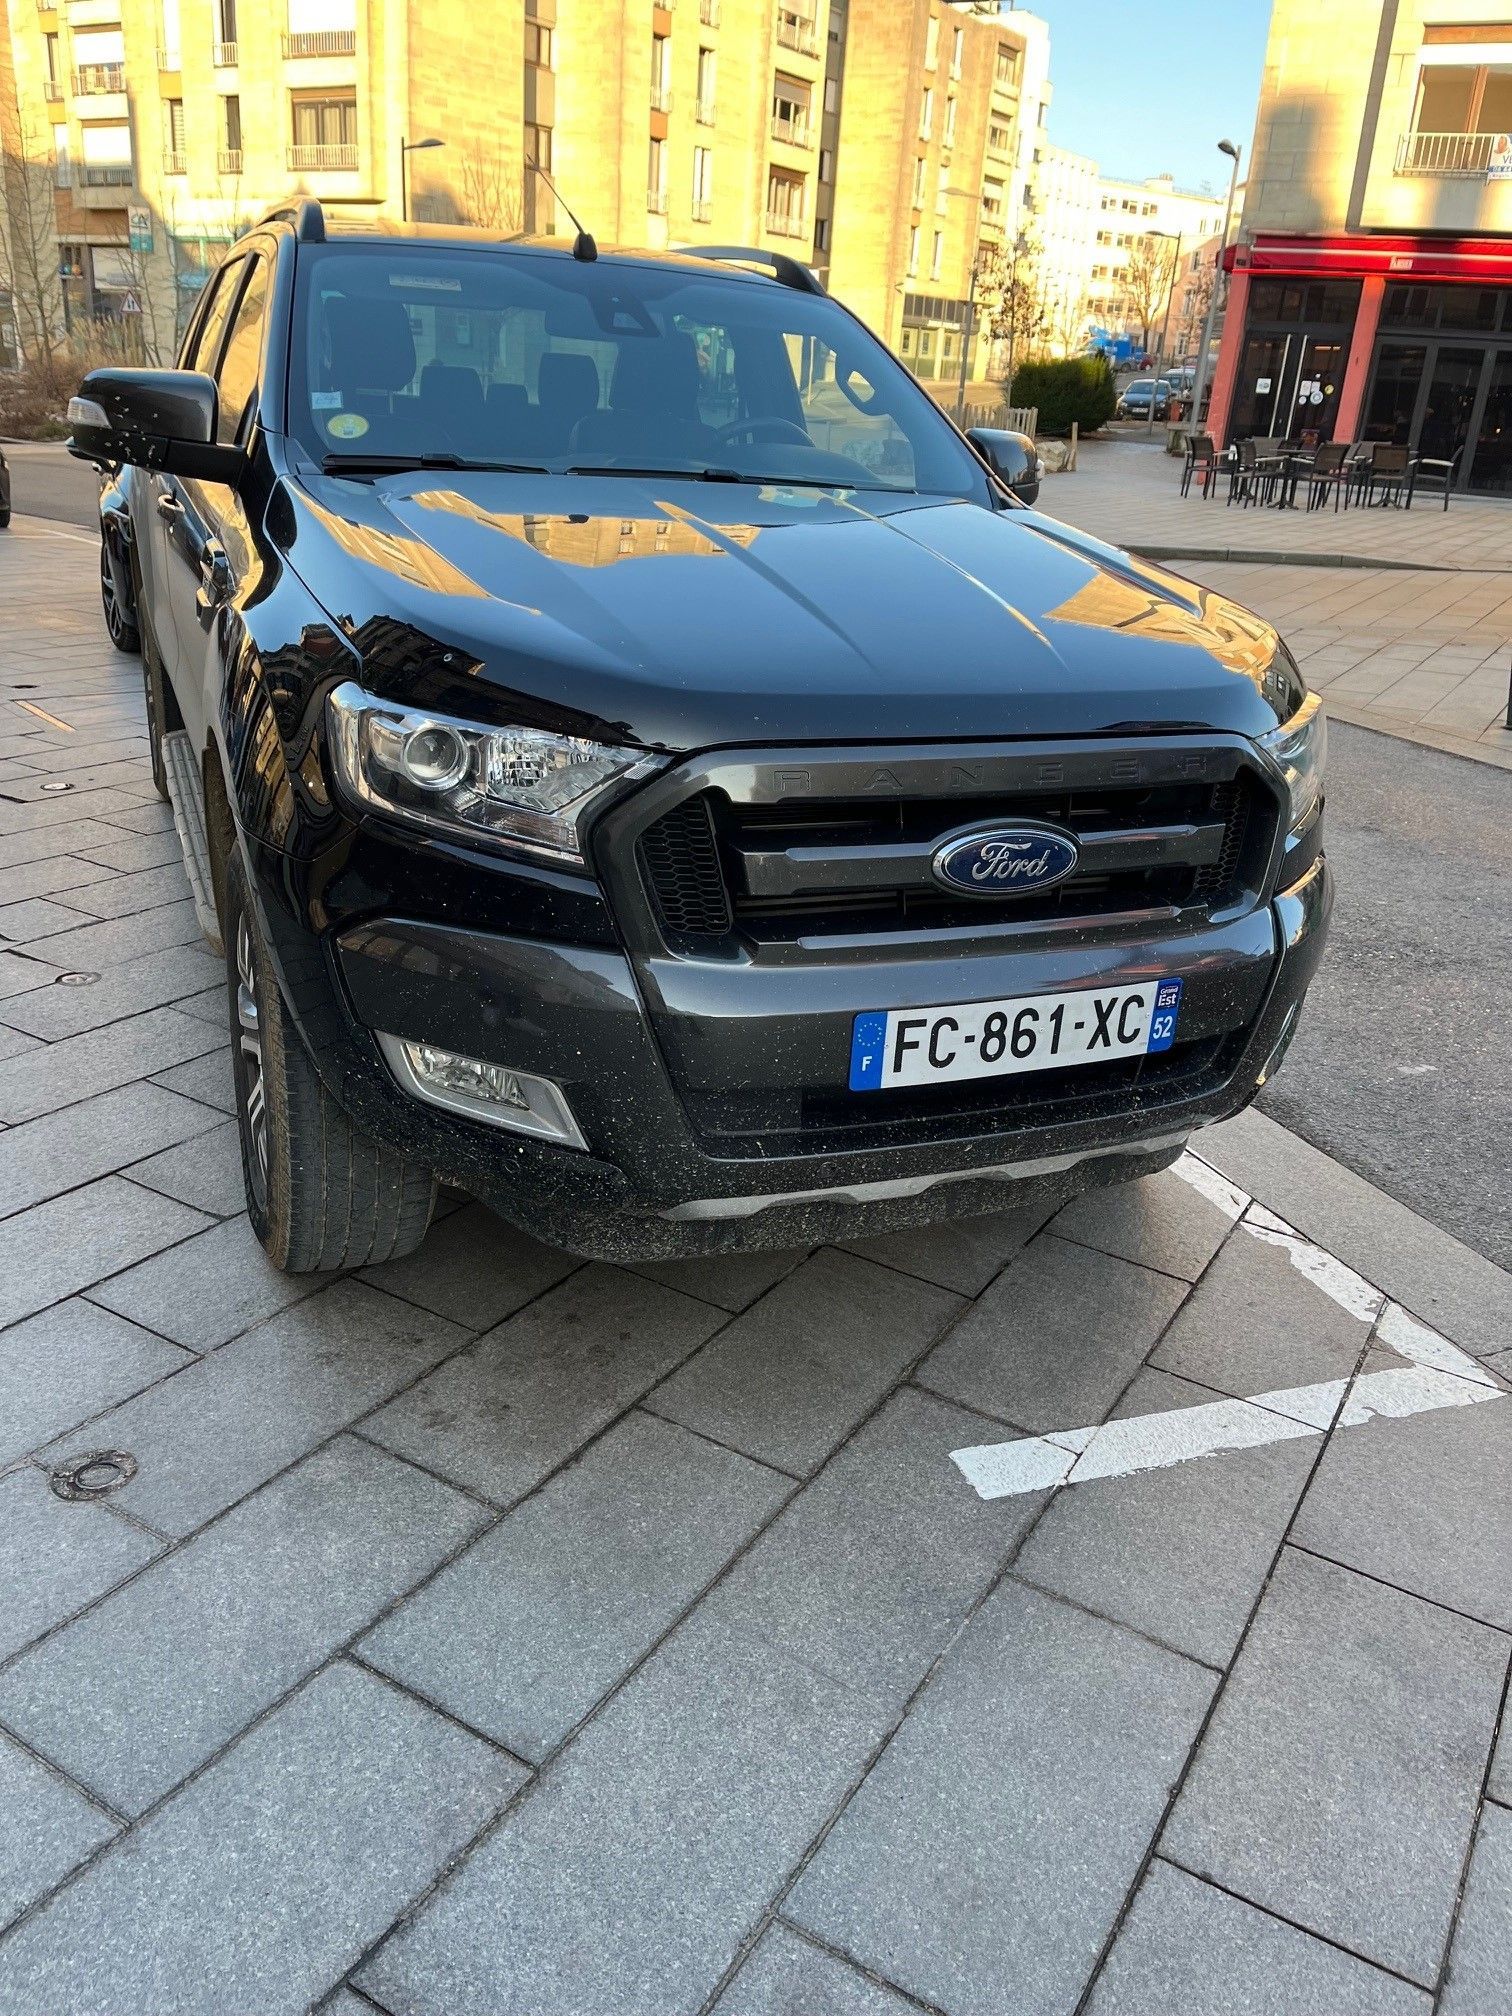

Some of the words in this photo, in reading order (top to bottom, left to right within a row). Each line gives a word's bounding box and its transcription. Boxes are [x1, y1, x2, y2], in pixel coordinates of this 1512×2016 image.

[773, 756, 1207, 791] RANGER
[972, 842, 1049, 880] Ford
[1158, 993, 1177, 1006] Est
[1160, 987, 1178, 995] Grand
[893, 993, 1145, 1073] FC-861-XC
[1153, 1015, 1173, 1039] 52
[861, 1056, 872, 1072] F
